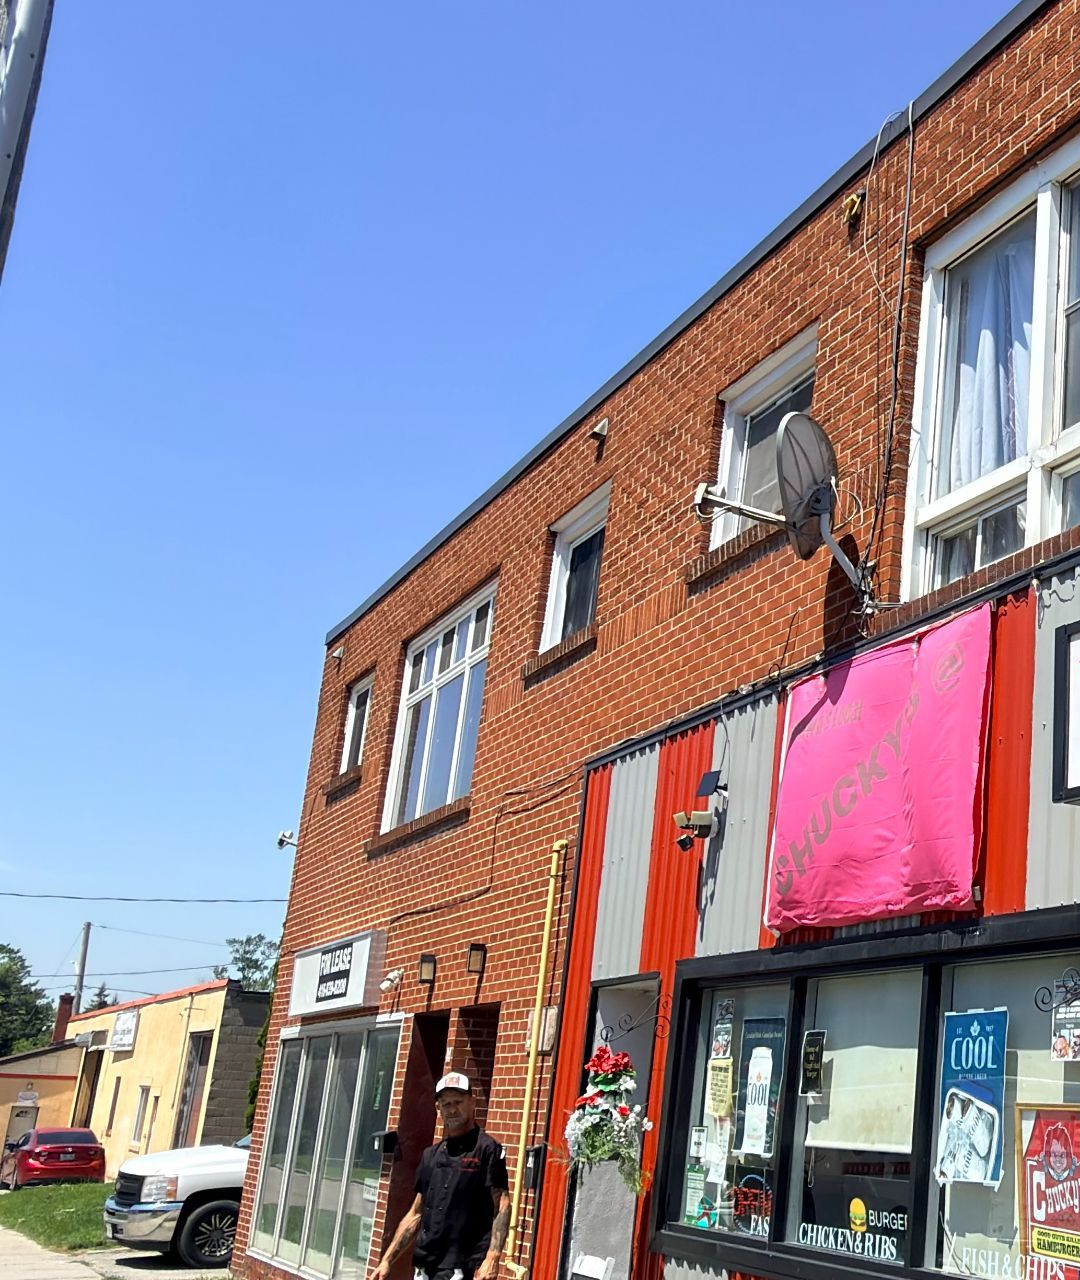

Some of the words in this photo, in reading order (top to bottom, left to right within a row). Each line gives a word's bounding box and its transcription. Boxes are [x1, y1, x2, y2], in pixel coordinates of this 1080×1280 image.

[331, 947, 352, 974] LEASE
[951, 1036, 998, 1070] COOL
[962, 1247, 999, 1276] FISH
[1002, 1254, 1013, 1279] &
